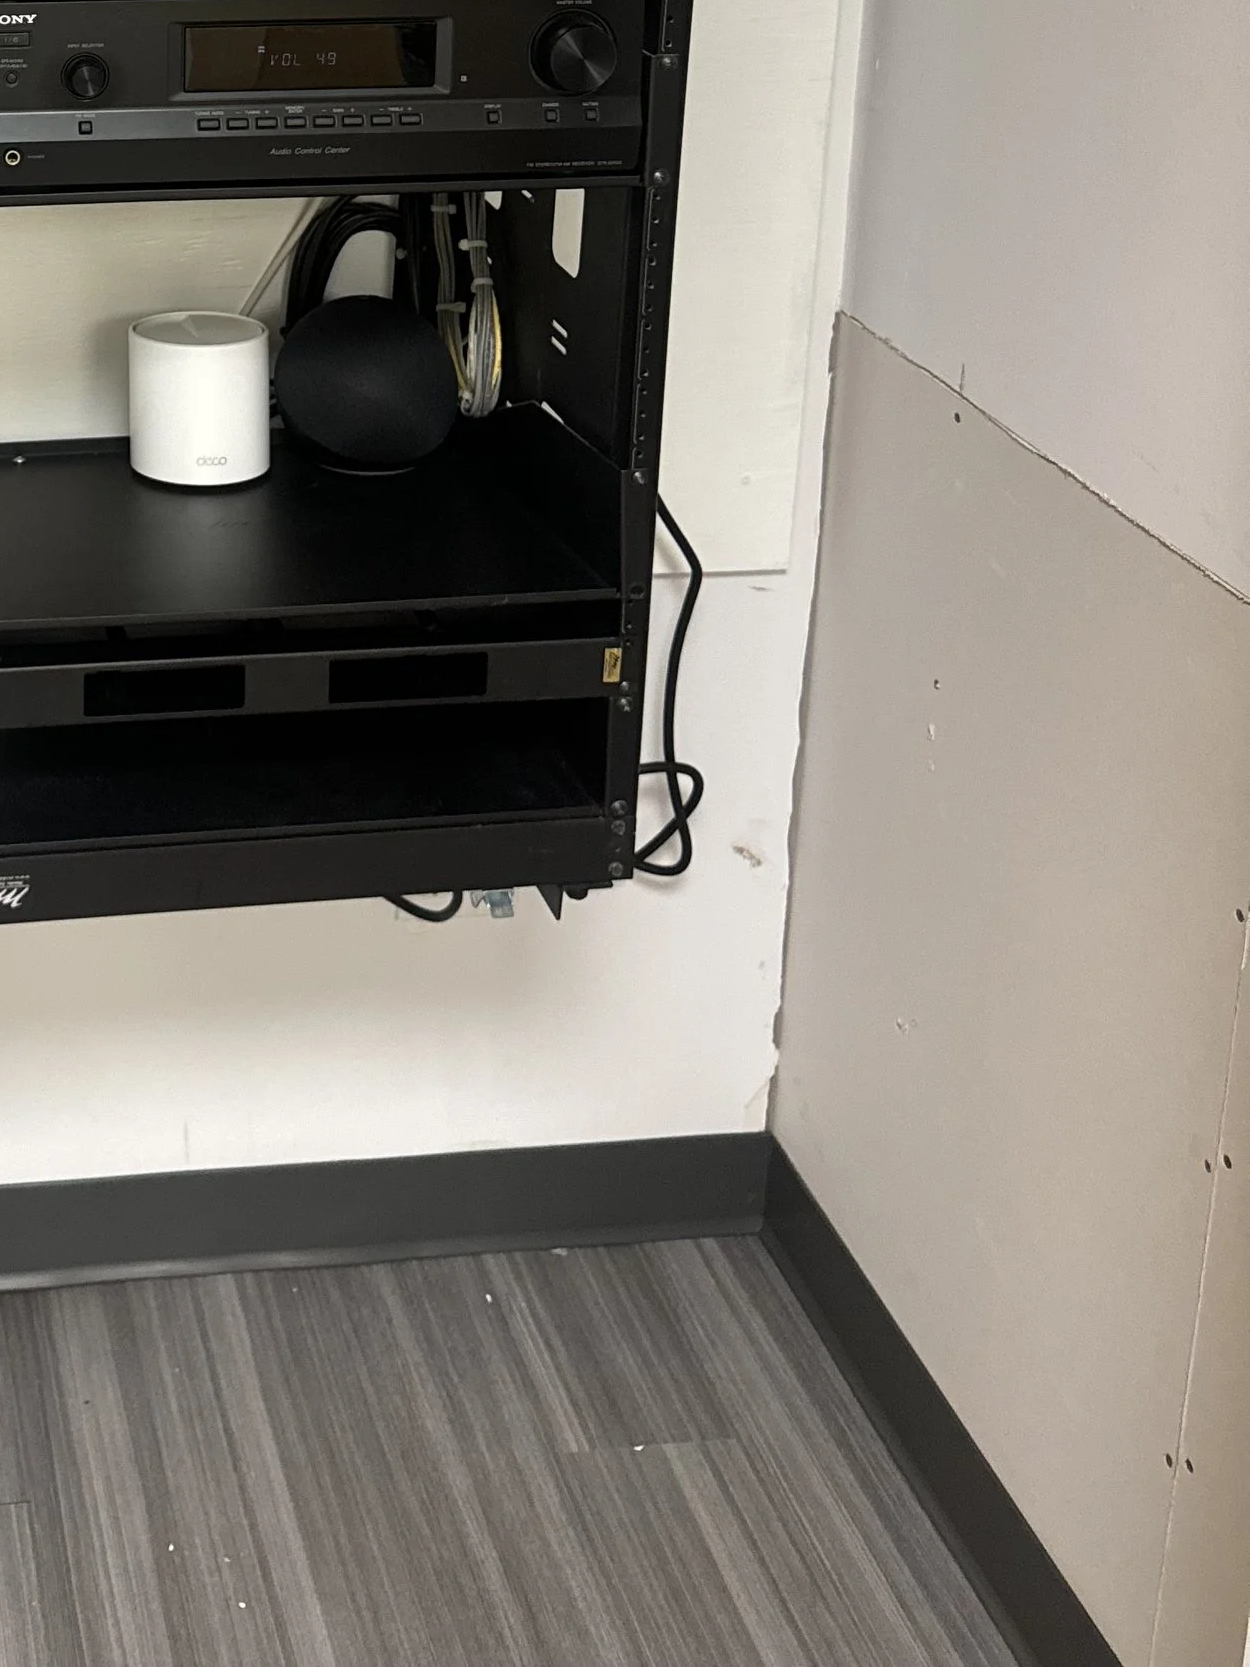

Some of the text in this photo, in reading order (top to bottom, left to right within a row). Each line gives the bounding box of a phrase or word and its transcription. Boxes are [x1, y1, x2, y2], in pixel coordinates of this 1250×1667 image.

[270, 52, 337, 66] VOL 49
[270, 146, 350, 156] Audio Control Center
[196, 455, 227, 466] deco
